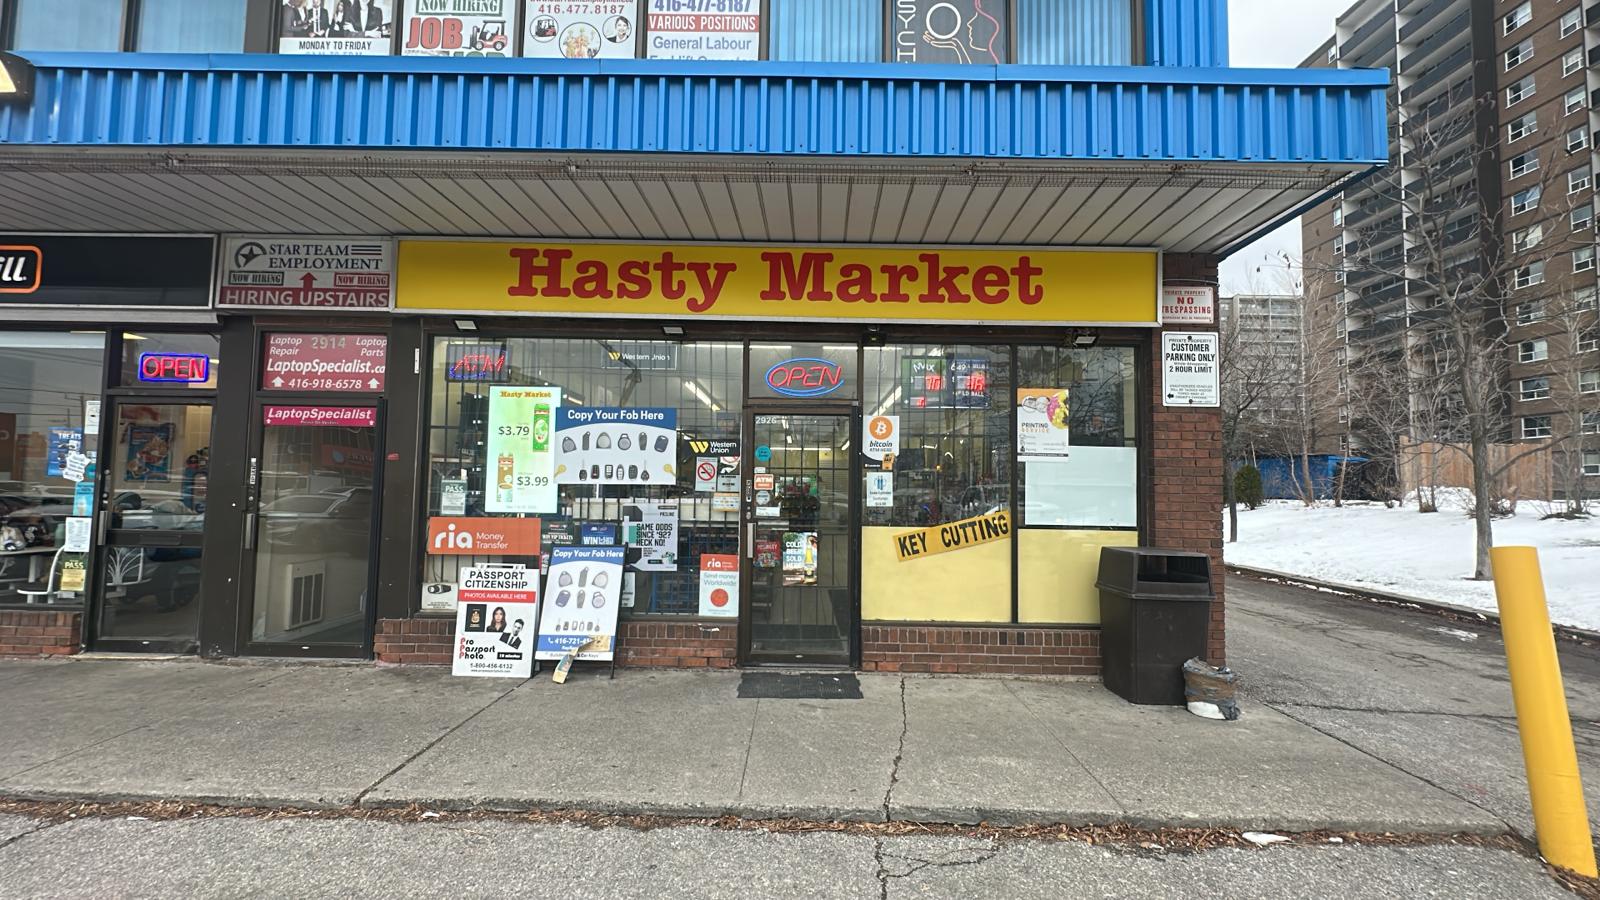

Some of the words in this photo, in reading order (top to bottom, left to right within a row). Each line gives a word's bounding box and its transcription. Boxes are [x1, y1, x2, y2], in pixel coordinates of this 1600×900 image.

[453, 0, 497, 12] HIRING
[539, 5, 625, 14] 416.477.8187
[649, 16, 696, 30] VARIOUS
[701, 16, 756, 30] POSITIONS
[406, 17, 463, 49] JOB
[299, 41, 331, 50] MONDAY
[333, 41, 343, 50] TO
[345, 41, 372, 50] FRIDAY
[653, 36, 703, 49] General
[706, 37, 752, 50] Labour
[269, 244, 299, 256] STAR
[302, 245, 349, 256] TEAM
[269, 257, 383, 270] EMPLOYMENT
[232, 273, 249, 283] NOW
[252, 273, 281, 284] HIRING
[337, 275, 354, 285] NOW
[357, 275, 387, 285] HIRING
[508, 247, 737, 313] Hasty
[760, 251, 1044, 306] Market
[226, 290, 293, 305] HIRING
[301, 291, 388, 307] UPSTAIRS
[270, 337, 302, 347] Laptop
[311, 337, 346, 349] 2914
[356, 338, 387, 348] Laptop
[270, 347, 300, 356] Repair
[360, 348, 384, 357] Parts
[1171, 344, 1210, 352] CUSTOMER
[1165, 353, 1196, 361] PARKING
[1198, 353, 1216, 362] ONLY
[142, 357, 207, 379] OPEN
[267, 358, 386, 375] LaptopSpecialist.ca
[1194, 366, 1212, 374] LIMIT
[769, 366, 841, 388] OPEN
[288, 378, 363, 389] 416-918-6578
[500, 391, 523, 399] Hasty
[268, 408, 372, 420] LaptopSpecialist
[567, 409, 593, 422] Copy
[595, 409, 618, 420] Your
[620, 409, 639, 420] Fob
[640, 410, 664, 420] Here
[498, 426, 530, 437] $3.79
[517, 476, 549, 487] $3.99
[755, 475, 774, 483] ATM
[636, 523, 654, 531] SAME
[655, 523, 673, 531] ODDS
[434, 523, 473, 549] ria
[476, 532, 505, 541] Money
[636, 531, 654, 539] SINCE
[898, 532, 928, 557] KEY
[941, 514, 1009, 548] CUTTING
[476, 540, 508, 549] Transfer
[583, 536, 598, 545] WIN
[654, 539, 665, 547] NO!
[553, 549, 572, 559] Copy
[574, 549, 591, 557] Your
[606, 550, 624, 558] Here
[707, 557, 722, 568] ria
[469, 570, 525, 580] PASSPORT
[465, 580, 528, 589] CITIZENSHIP
[460, 637, 474, 645] Pro
[459, 645, 496, 654] Passport
[459, 652, 484, 660] Photo
